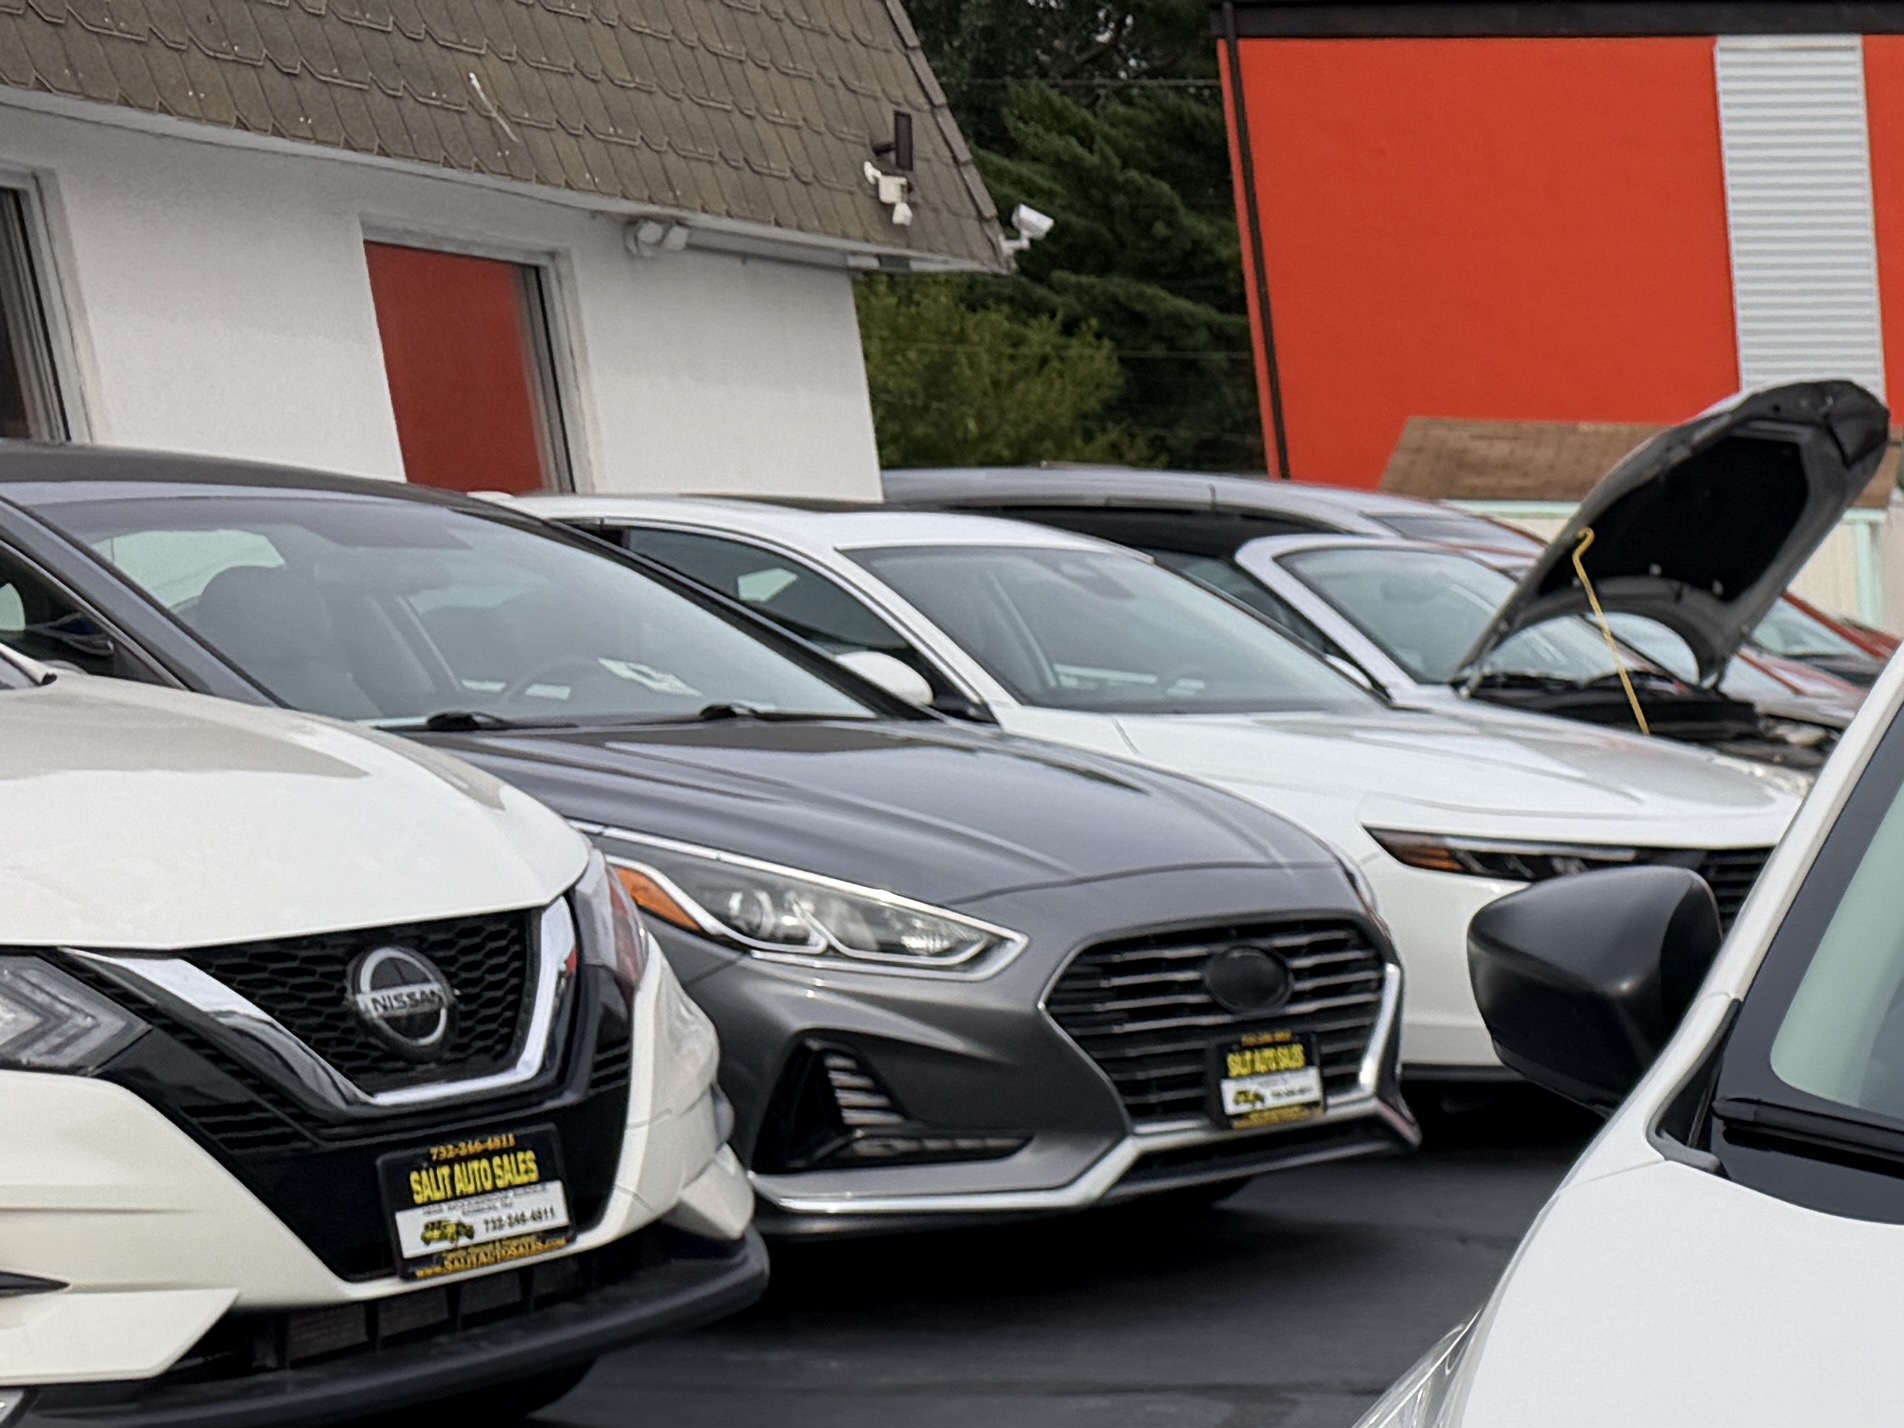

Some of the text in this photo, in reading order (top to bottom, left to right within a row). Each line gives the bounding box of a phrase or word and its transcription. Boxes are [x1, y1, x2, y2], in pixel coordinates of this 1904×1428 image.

[370, 990, 443, 1013] NISSAN
[410, 1166, 451, 1204] SALIT
[453, 1158, 494, 1196] AUTO
[492, 1150, 540, 1188] SALES
